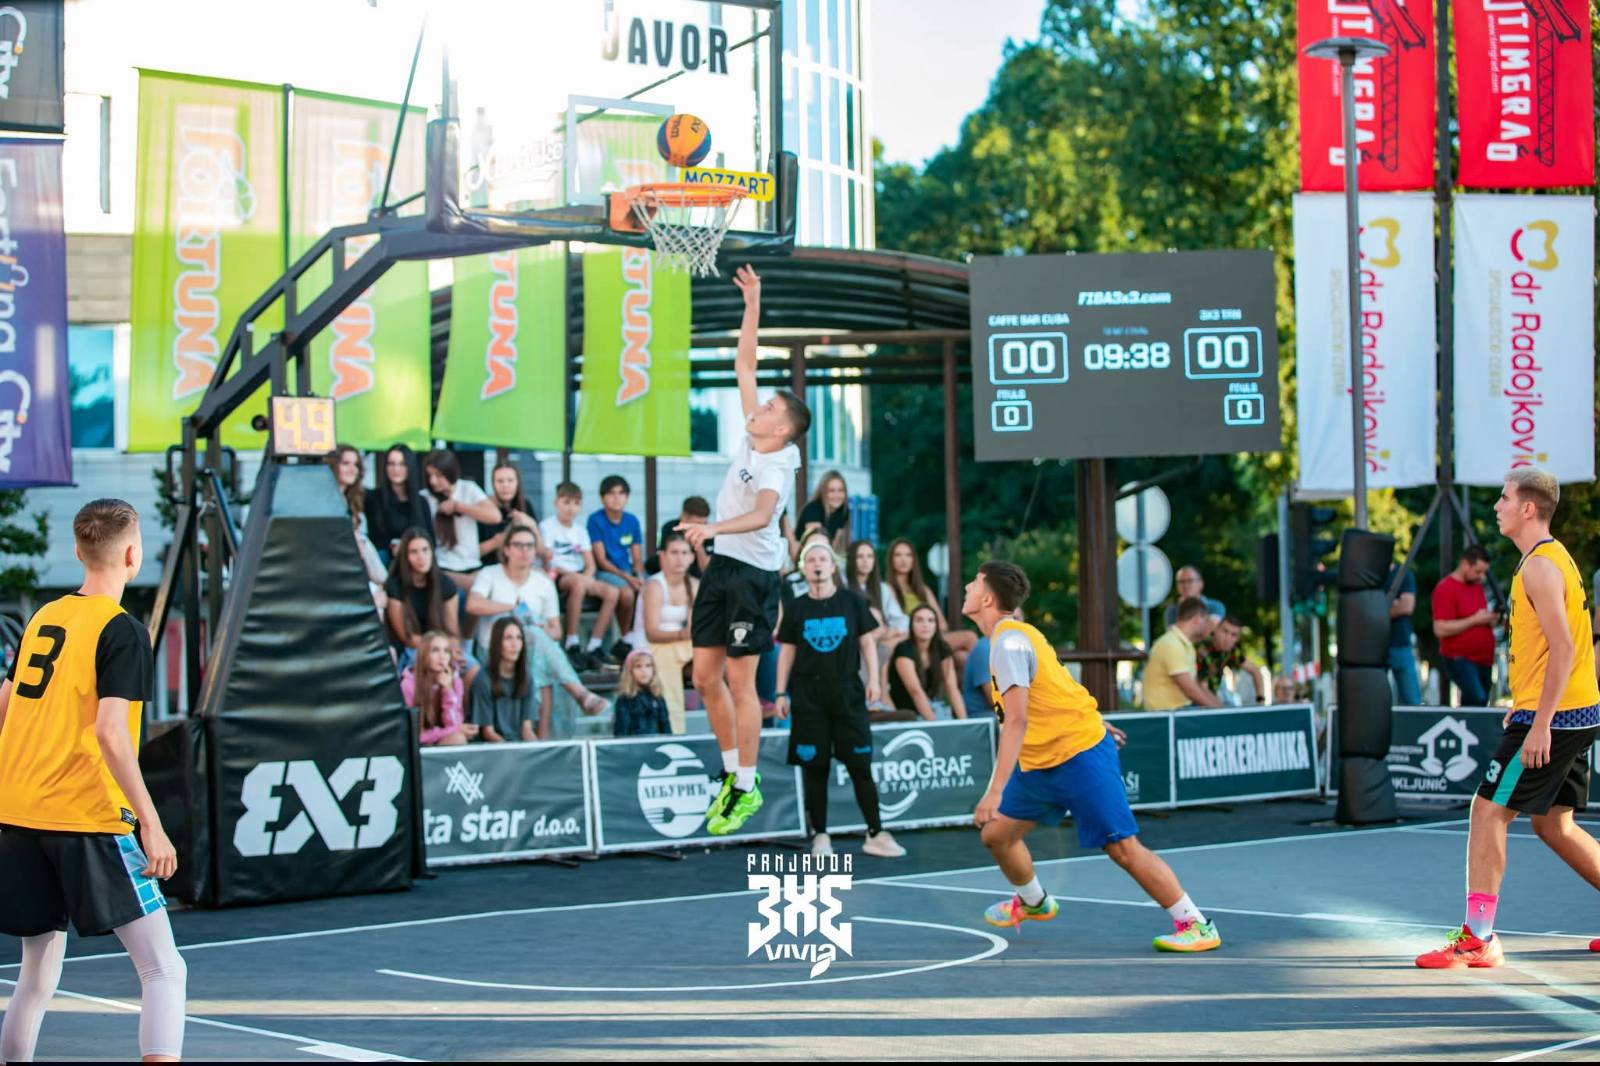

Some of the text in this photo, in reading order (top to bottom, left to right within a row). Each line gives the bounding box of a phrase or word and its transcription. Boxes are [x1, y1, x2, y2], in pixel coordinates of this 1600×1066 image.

[1511, 271, 1542, 303] dr
[1002, 340, 1055, 374] 00
[1084, 342, 1171, 370] 09:38
[1197, 335, 1249, 369] 00
[1003, 406, 1020, 425] 0
[1236, 399, 1253, 419] 0
[16, 624, 67, 700] 3
[836, 754, 973, 787] PTROGRAF
[1177, 730, 1310, 780] INKERKERAMIKA
[460, 804, 526, 842] star
[533, 813, 581, 837] d.o.o.
